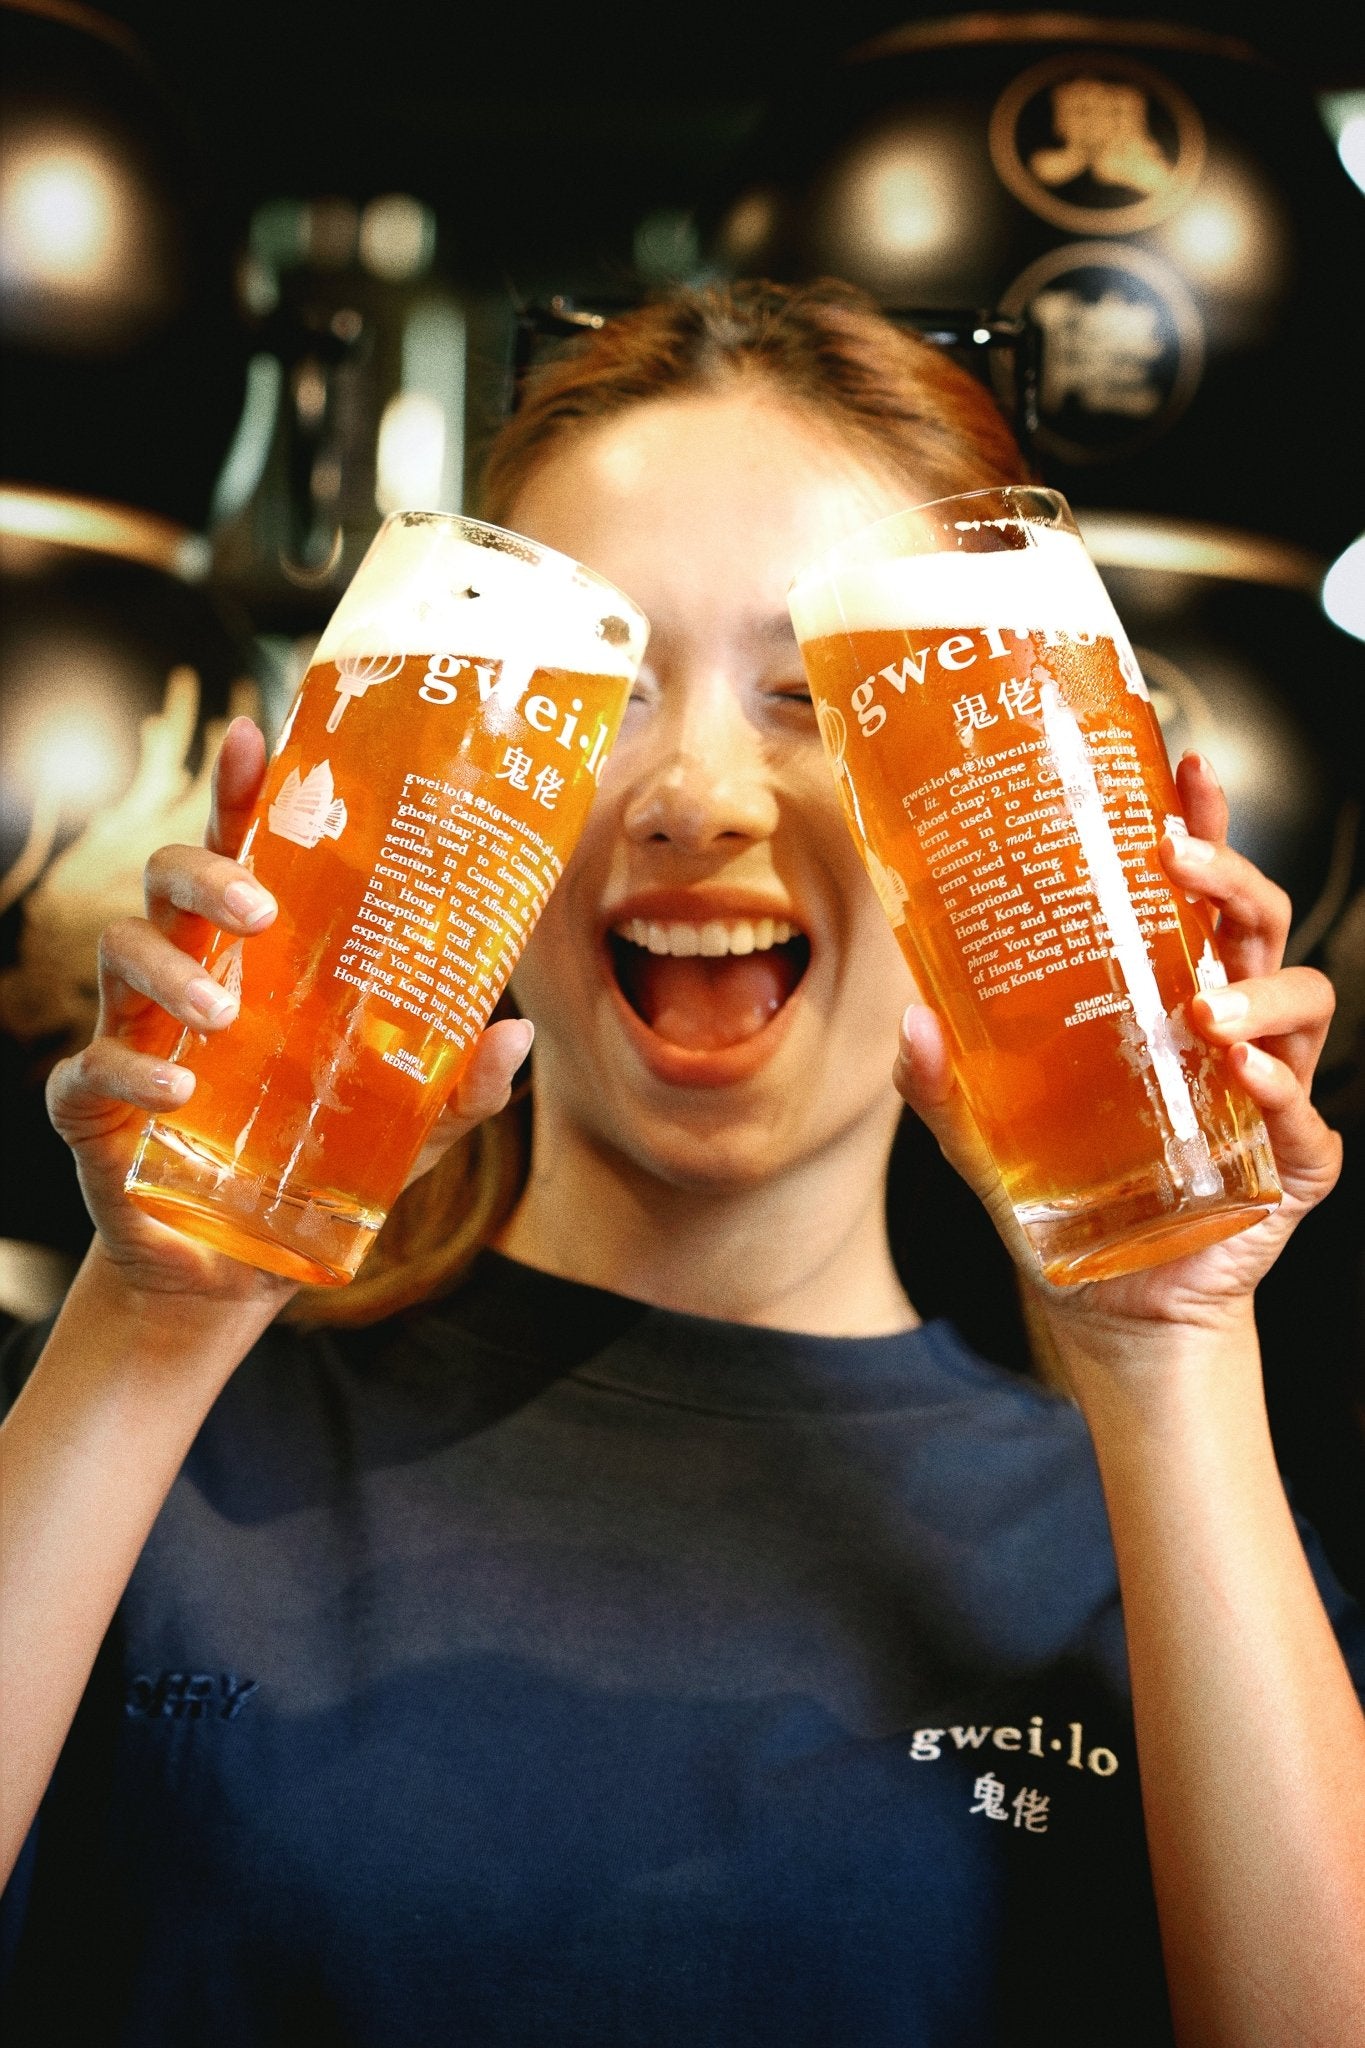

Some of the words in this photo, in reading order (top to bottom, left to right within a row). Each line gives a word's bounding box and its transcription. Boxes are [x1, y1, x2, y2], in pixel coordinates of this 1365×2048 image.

[952, 677, 1042, 733] 鬼佬
[495, 746, 565, 810] 鬼佬
[950, 762, 1026, 797] Cantonese
[990, 785, 1005, 799] 2.
[1008, 776, 1035, 793] hist.
[401, 785, 411, 798] 1.
[450, 803, 514, 845] Cantonese
[520, 843, 541, 866] term
[476, 834, 489, 849] 2.
[920, 829, 949, 851] term
[960, 806, 993, 829] used
[1004, 800, 1020, 812] to
[927, 838, 969, 865] settlers
[978, 827, 994, 839] in
[1005, 806, 1059, 828] Canton
[932, 849, 986, 879] Century.
[1005, 827, 1037, 847] mod.
[380, 846, 438, 879] Century.
[384, 833, 434, 859] settlers
[442, 853, 457, 870] in
[466, 866, 505, 898] Canton
[509, 893, 518, 909] in
[391, 817, 426, 839] term
[436, 835, 469, 857] used
[476, 854, 490, 868] to
[496, 865, 531, 899] describe
[938, 875, 967, 894] term
[972, 855, 1005, 877] used
[1011, 851, 1026, 862] to
[1032, 832, 1082, 854] describ
[367, 875, 383, 892] in
[397, 887, 437, 916] Hong
[374, 862, 408, 884] term
[414, 878, 446, 900] used
[449, 894, 463, 908] to
[465, 903, 503, 937] describe
[943, 899, 957, 910] in
[969, 874, 1008, 897] Hong
[949, 883, 1024, 924] Exceptional
[1033, 870, 1067, 889] craft
[356, 906, 396, 933] Hong
[401, 924, 436, 952] Kong,
[442, 944, 478, 975] brewed
[362, 891, 440, 934] Exceptional
[446, 931, 471, 952] craft
[474, 946, 493, 968] beer
[955, 918, 989, 940] Hong
[994, 901, 1034, 922] Kong,
[961, 925, 1015, 955] expertise
[1020, 911, 1047, 930] and
[1052, 901, 1092, 920] above
[967, 949, 1000, 974] phrase
[1003, 937, 1031, 953] You
[1033, 928, 1058, 943] can
[1060, 918, 1090, 934] take
[342, 938, 384, 961] phrase
[390, 953, 414, 975] You
[414, 970, 436, 987] can
[435, 981, 456, 1000] take
[455, 994, 470, 1010] the
[351, 924, 411, 955] expertise
[413, 950, 439, 970] and
[438, 965, 467, 988] above
[973, 969, 985, 985] of
[988, 957, 1024, 979] Hong
[1026, 943, 1064, 963] Kong
[1066, 934, 1092, 950] but
[1095, 930, 1112, 945] yo
[977, 980, 1011, 1001] Hong
[1010, 967, 1045, 987] Kong
[1045, 958, 1069, 974] out
[1070, 950, 1086, 966] of
[1087, 946, 1109, 961] the
[332, 965, 371, 993] Hong
[370, 981, 404, 1009] Kong
[403, 1001, 423, 1017] out
[421, 1012, 437, 1024] of
[433, 1017, 449, 1034] the
[339, 954, 358, 966] of
[357, 958, 396, 987] Hong
[397, 976, 430, 1004] Kong
[430, 994, 448, 1013] but
[446, 1008, 464, 1026] you
[1064, 999, 1131, 1028] REDEFINING
[1074, 992, 1113, 1013] SIMPLY
[381, 1051, 428, 1086] REDEFINING
[396, 1048, 426, 1071] SIMPLY
[968, 1771, 1051, 1833] 鬼佬
